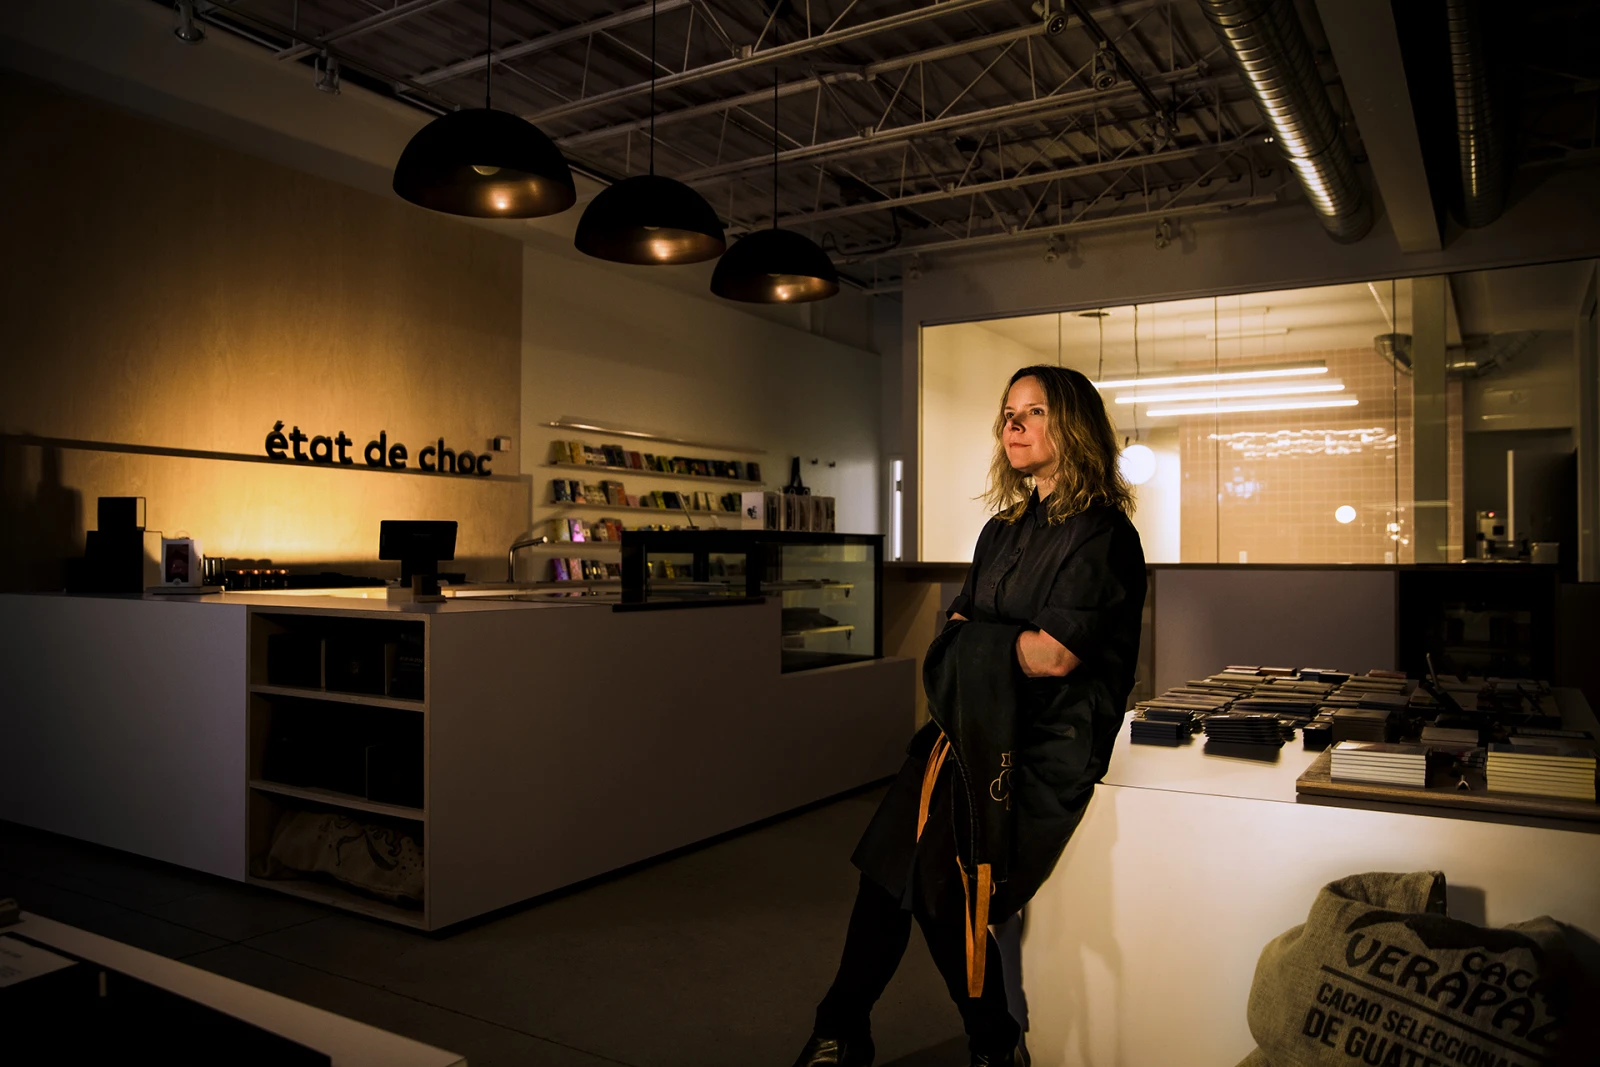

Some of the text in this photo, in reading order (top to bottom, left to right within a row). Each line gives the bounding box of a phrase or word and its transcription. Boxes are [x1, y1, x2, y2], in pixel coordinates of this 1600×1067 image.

[265, 420, 492, 476] état de choc
[1316, 983, 1383, 1024] CACAO
[1302, 1006, 1450, 1067] DE GUAT
